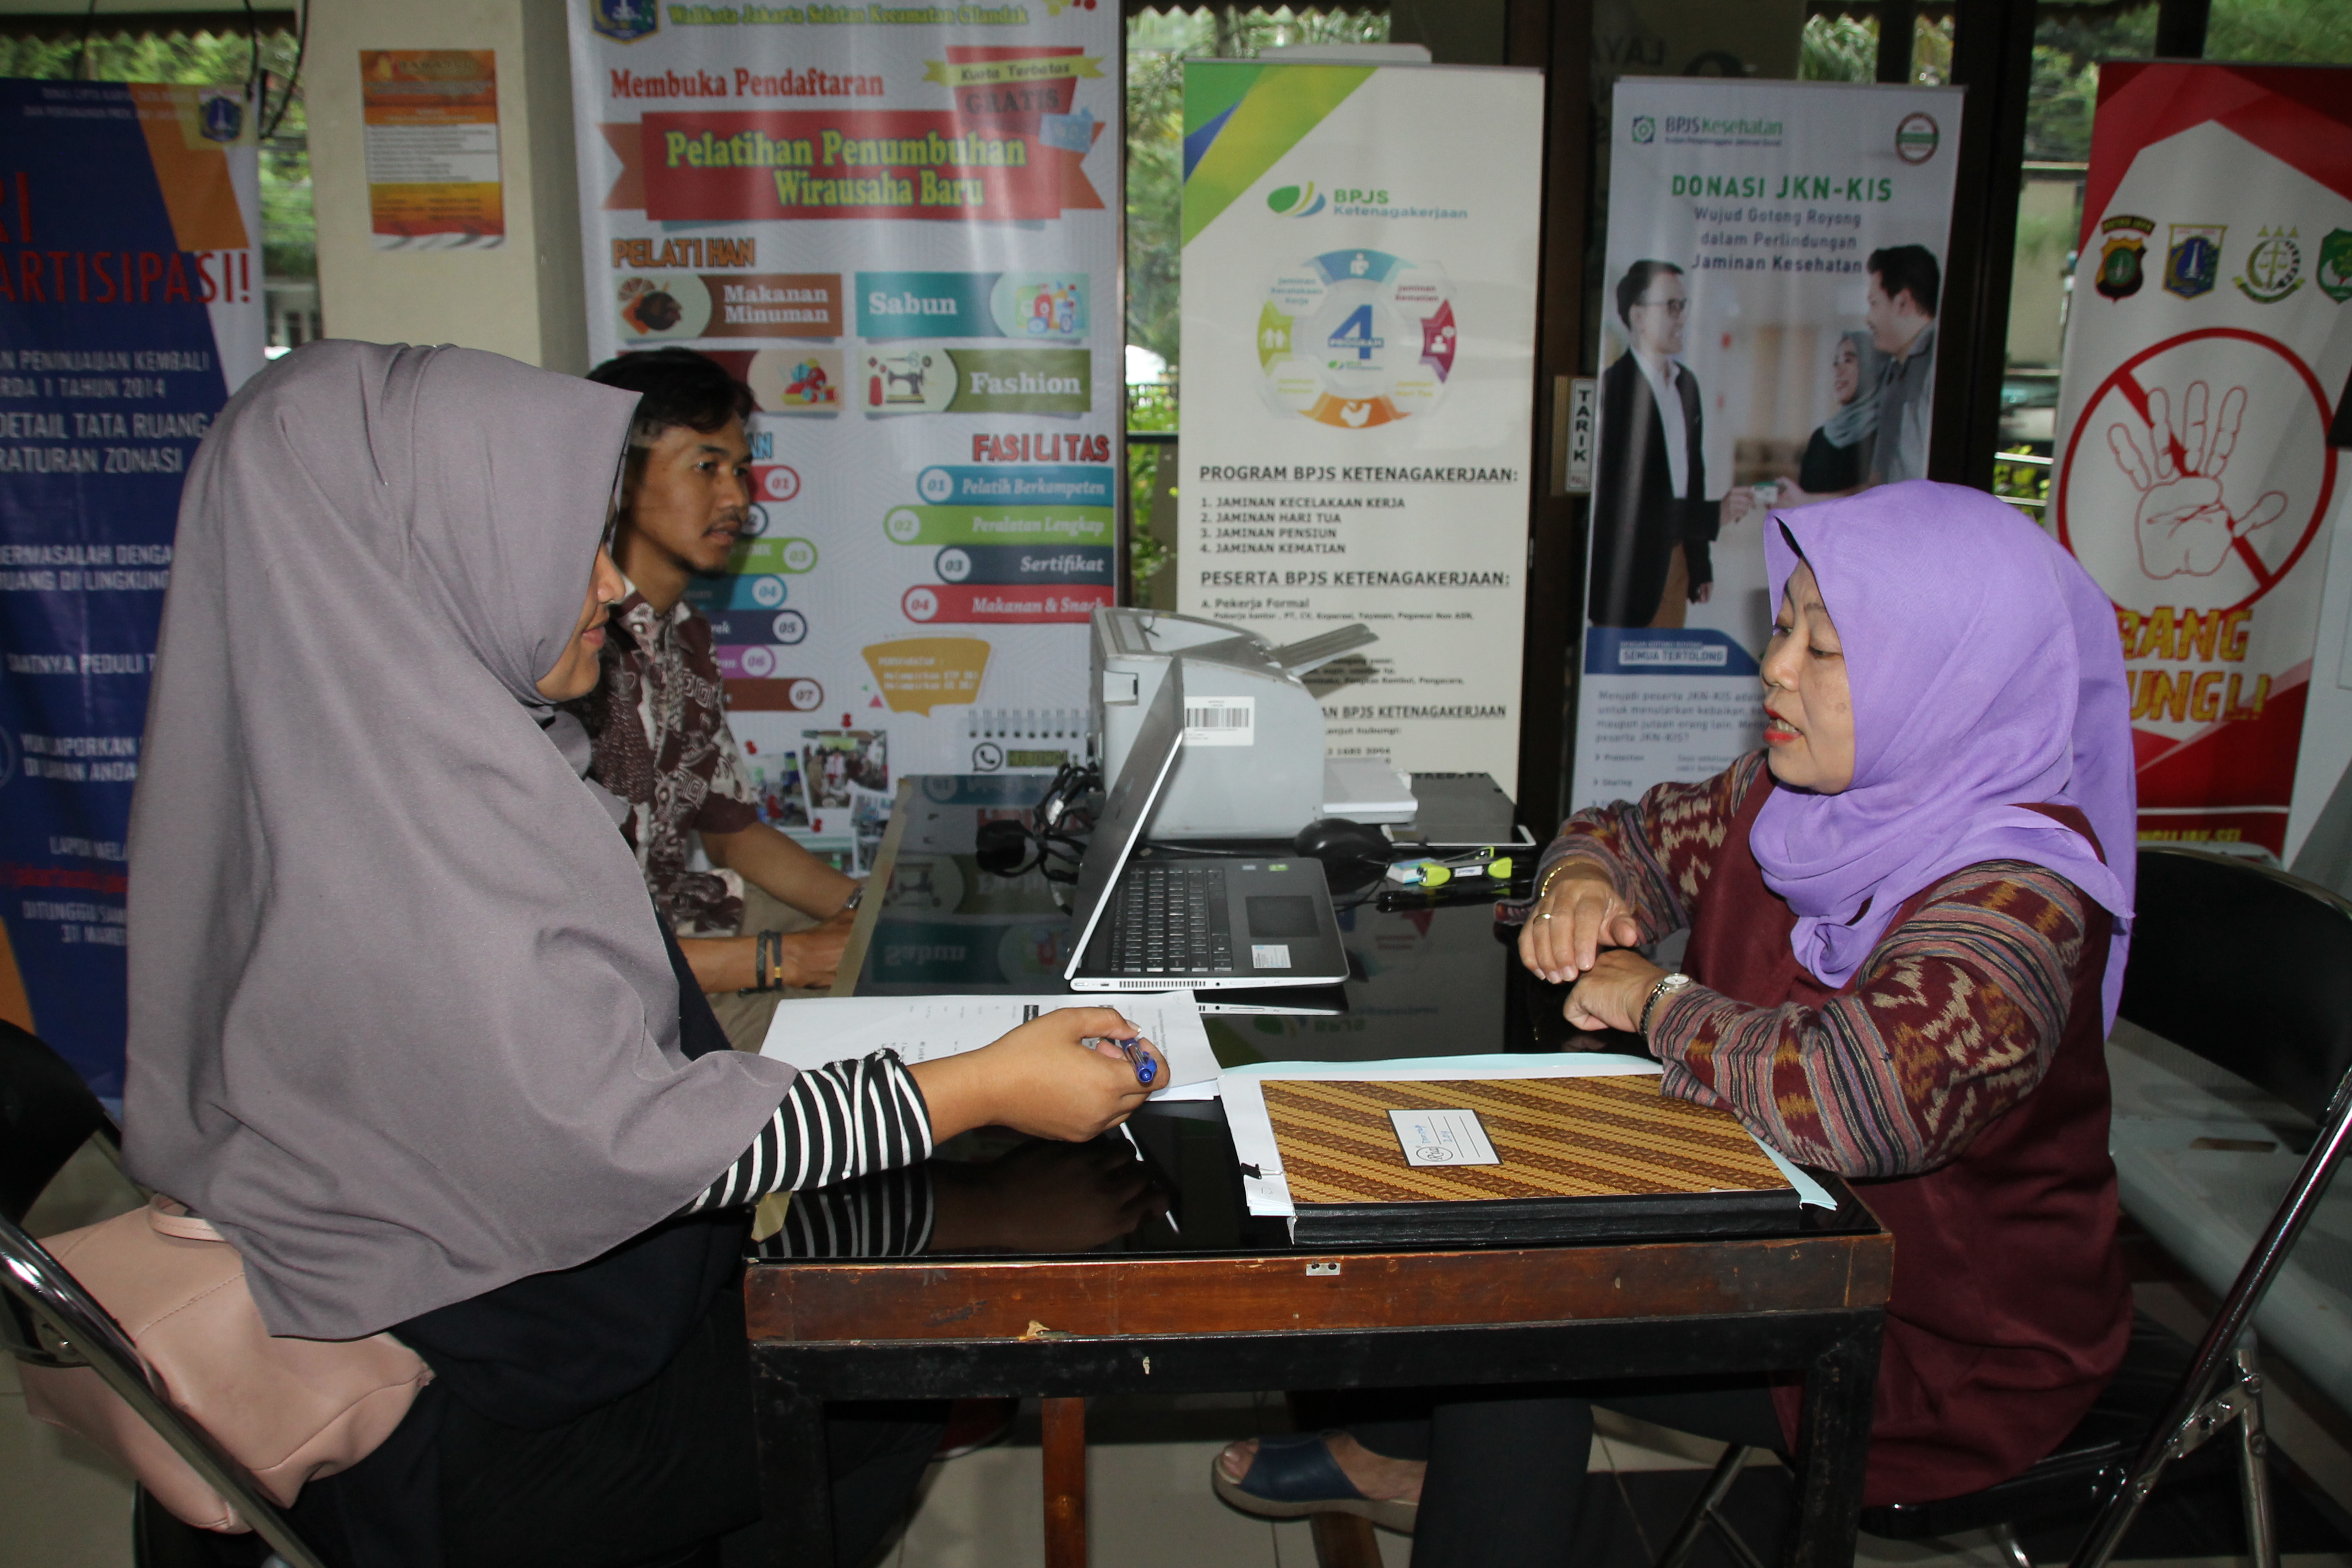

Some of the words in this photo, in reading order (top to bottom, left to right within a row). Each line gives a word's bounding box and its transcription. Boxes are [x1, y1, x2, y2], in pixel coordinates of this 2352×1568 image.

[1007, 63, 1070, 77] Terbatas
[611, 69, 728, 98] Membuka
[734, 67, 884, 97] Pendaftaran
[965, 88, 1059, 114] GRATIS
[1665, 115, 1700, 134] BPJS
[665, 130, 815, 167] Pelatihan
[820, 128, 1028, 167] Penumbuhan
[774, 168, 914, 207] Wirausaha
[919, 168, 986, 207] Baru
[1333, 189, 1390, 204] BPJS
[1672, 175, 1765, 198] DONASI
[1776, 175, 1893, 202] JKN-KIS
[1333, 204, 1468, 220] Ketenagakerjaan
[1694, 206, 1743, 224] Wujud
[1700, 231, 1748, 246] dalam
[1752, 231, 1857, 251] Perlindungan
[611, 238, 755, 268] PELATIHAN
[1691, 254, 1766, 270] Jaminan
[1772, 254, 1863, 273] Kesehatan
[722, 284, 829, 303] Makanan
[868, 291, 957, 315] Sabun
[723, 304, 830, 324] Minuman
[1327, 304, 1373, 360] 4
[134, 351, 210, 372] KEMBALI
[58, 377, 119, 398] TAHUN
[122, 377, 166, 399] 2014
[969, 372, 1082, 395] Fashion
[73, 412, 129, 440] TATA
[133, 412, 210, 440] RUANG
[1574, 390, 1591, 461] TARIK
[972, 433, 1110, 462] FASILITAS
[104, 447, 184, 474] ZONASI
[772, 477, 790, 490] 01
[1200, 466, 1287, 480] PROGRAM
[1293, 466, 1336, 480] BPJS
[1342, 467, 1518, 482] KETENAGAKERJAAN:
[927, 478, 945, 493] 01
[1216, 497, 1275, 508] JAMINAN
[1279, 497, 1363, 508] KECELAKAAN
[1366, 497, 1405, 508] KERJA
[894, 520, 913, 533] 02
[1216, 512, 1275, 523] JAMINAN
[1278, 513, 1311, 523] HARI
[1317, 513, 1342, 523] TUA
[1216, 527, 1275, 538] JAMINAN
[1278, 527, 1337, 538] PENSIUN
[1216, 543, 1275, 553] JAMINAN
[1278, 543, 1347, 553] KEMATIAN
[945, 558, 963, 572] 03
[1020, 554, 1105, 575] Sertifikat
[1201, 571, 1279, 585] PESERTA
[1285, 571, 1327, 585] BPJS
[1333, 571, 1510, 586] KETENAGAKERJAAN:
[759, 585, 777, 599] 04
[911, 599, 930, 612] 04
[972, 597, 1042, 613] Makanan
[1215, 597, 1262, 609] Pekerja
[1266, 597, 1310, 608] Formal
[778, 623, 797, 634] 05
[80, 653, 144, 674] PEDULI
[1624, 650, 1660, 661] SEMUA
[1664, 650, 1724, 661] TERTOLONG
[795, 690, 813, 701] 07
[1342, 705, 1374, 717] BPJS
[1378, 705, 1507, 718] KETENAGAKERJAAN
